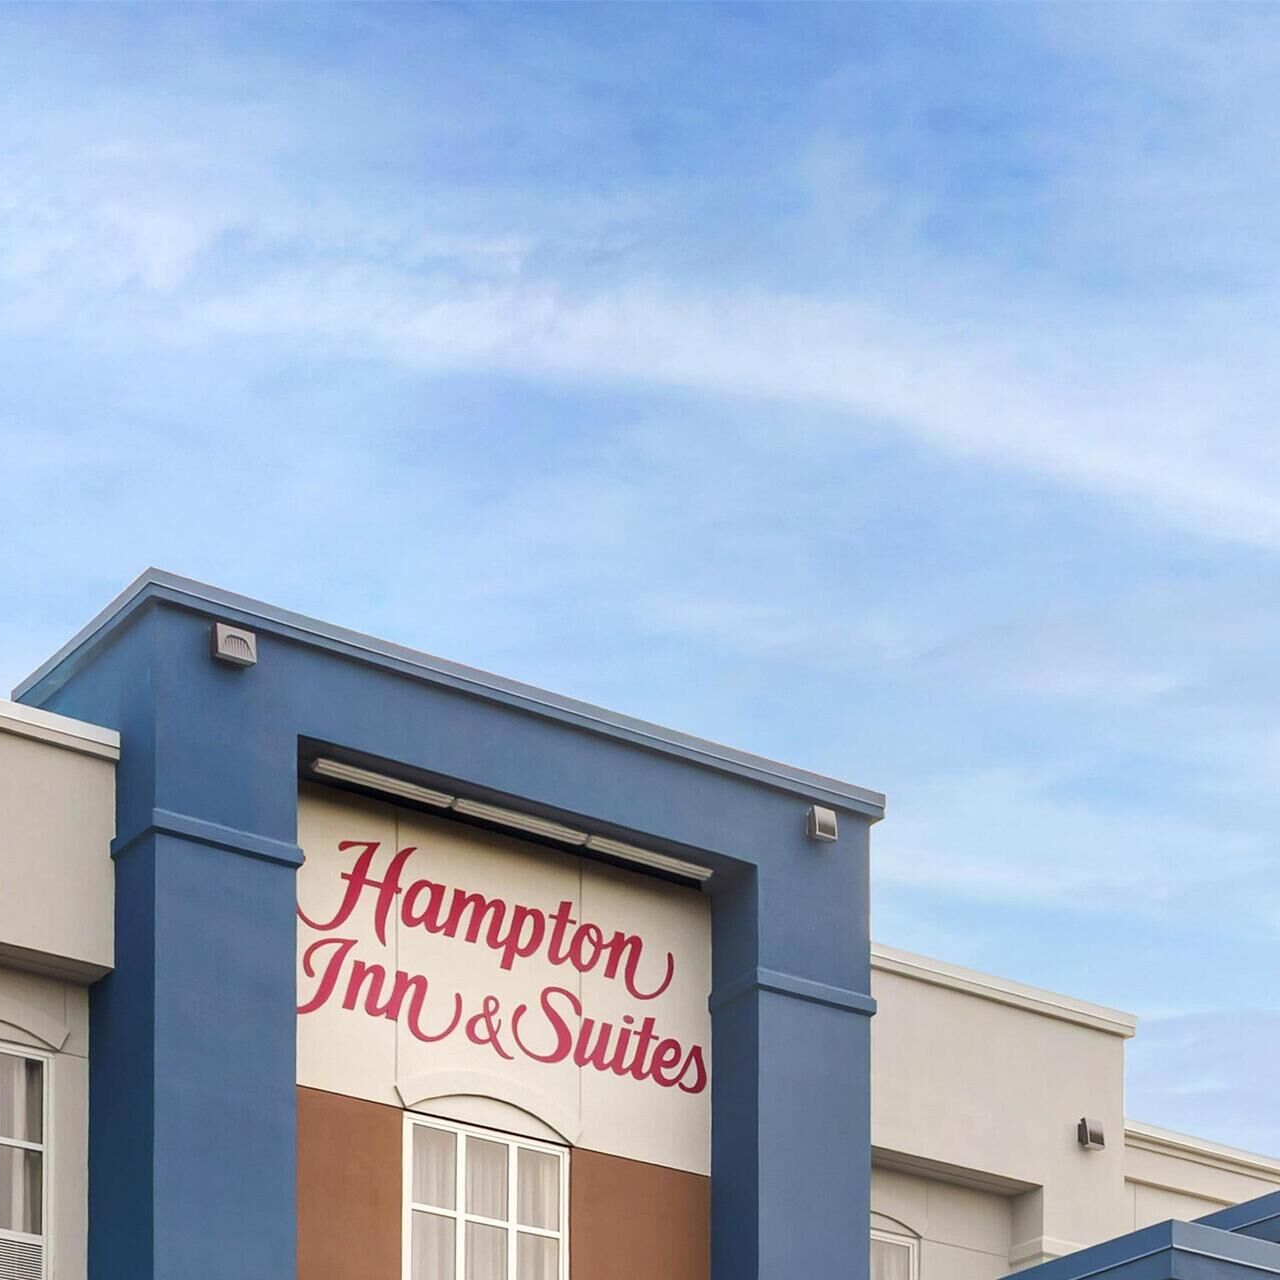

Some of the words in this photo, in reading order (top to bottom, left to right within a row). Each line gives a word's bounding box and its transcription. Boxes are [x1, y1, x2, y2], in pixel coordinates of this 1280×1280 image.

[297, 841, 674, 1000] Hampton
[297, 938, 463, 1043] Inn
[465, 995, 515, 1060] &
[511, 986, 708, 1094] Suites
